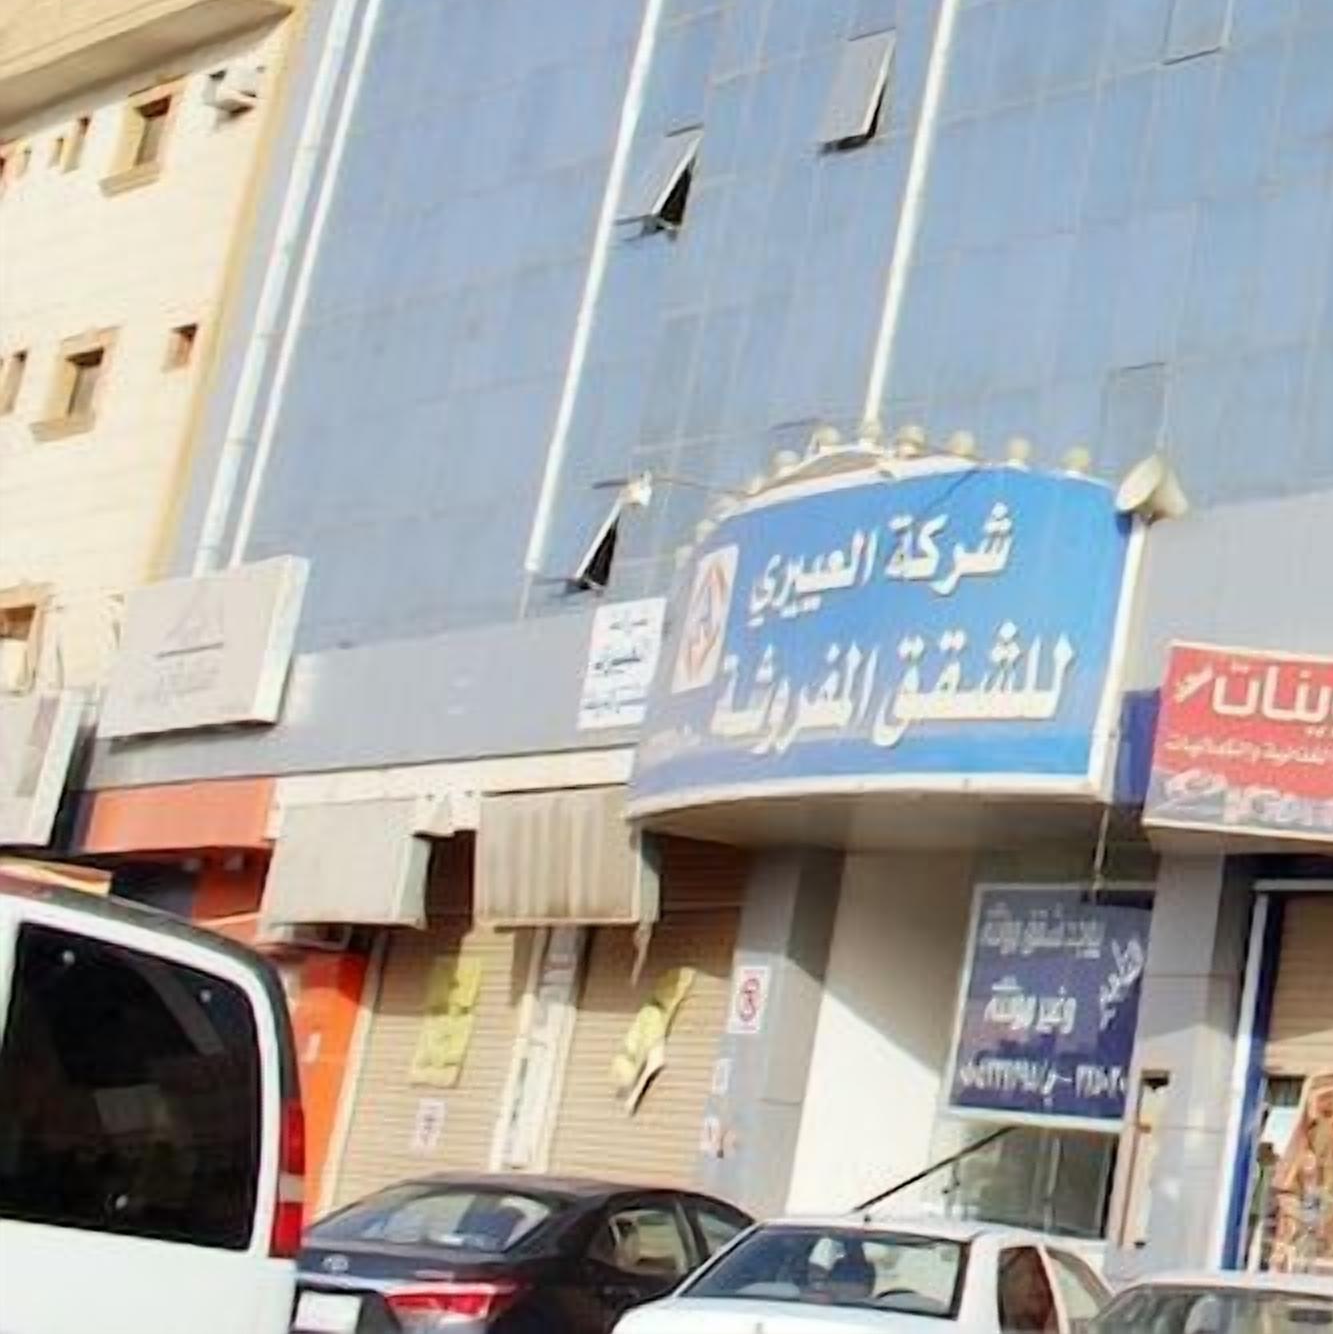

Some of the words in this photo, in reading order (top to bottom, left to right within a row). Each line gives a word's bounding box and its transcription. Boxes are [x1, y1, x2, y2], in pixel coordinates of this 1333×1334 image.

[884, 501, 1014, 596] شركة
[710, 639, 876, 756] المفروشة
[872, 621, 1073, 747] للشقق
